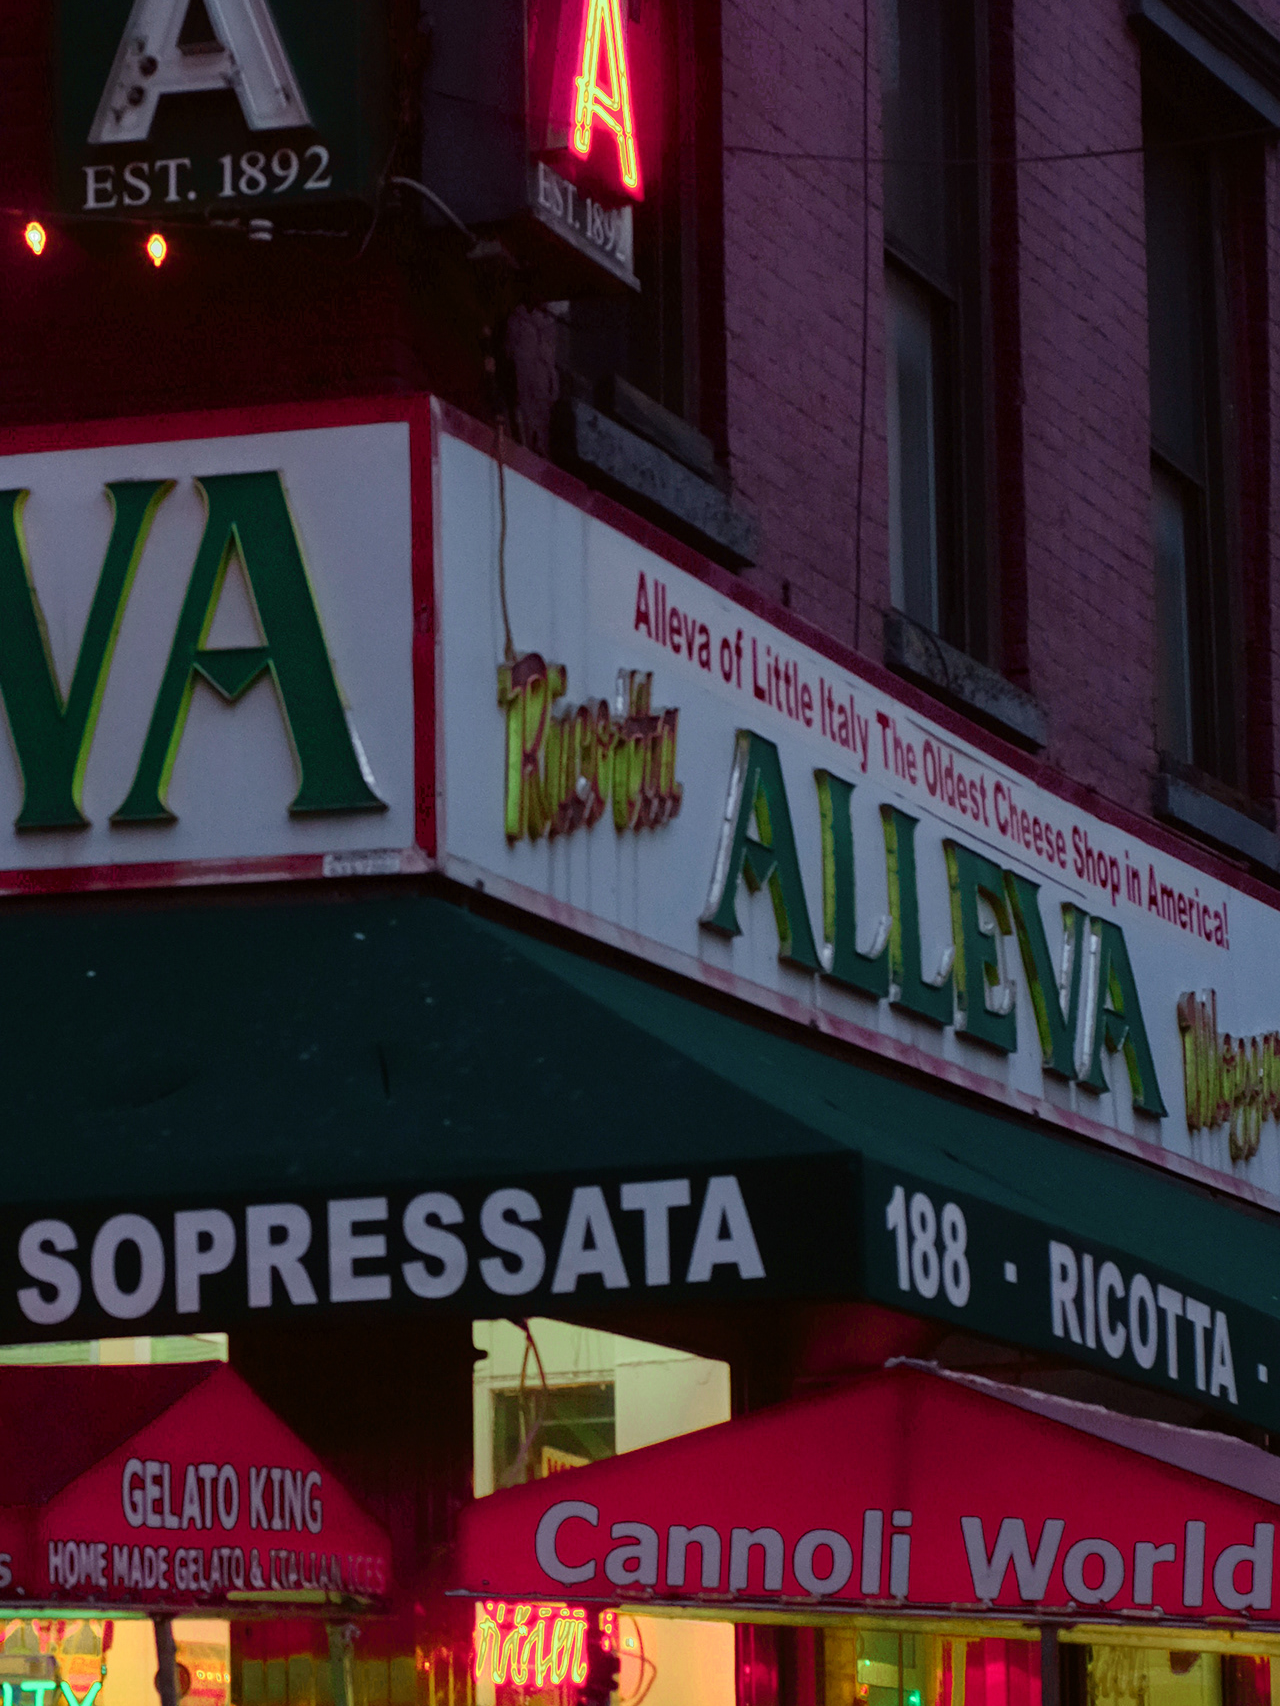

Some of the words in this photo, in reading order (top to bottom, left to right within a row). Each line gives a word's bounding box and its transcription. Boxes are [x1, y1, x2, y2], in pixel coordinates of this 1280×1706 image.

[82, 158, 197, 210] EST.
[219, 145, 332, 197] 1892
[634, 570, 711, 672] Alleva
[721, 628, 742, 689] of
[752, 637, 814, 728] Little
[820, 677, 869, 773] Italy
[877, 710, 918, 786] The
[923, 738, 989, 827] Oldest
[993, 780, 1067, 870] Cheese
[1072, 825, 1121, 907] Shop
[1125, 850, 1143, 907] in
[1148, 863, 1230, 951] America!
[699, 728, 1169, 1119] ALLEVA
[15, 1174, 767, 1326] SOPRESSATA
[885, 1184, 971, 1308] 188
[1048, 1239, 1239, 1406] RICOTTA
[122, 1458, 240, 1531] GELATO
[249, 1466, 323, 1535] KING
[534, 1500, 913, 1601] Cannoli
[960, 1515, 1275, 1611] World
[48, 1541, 109, 1589] HOME
[112, 1545, 170, 1590] MADE
[173, 1547, 246, 1591] GELATO
[249, 1548, 267, 1590] &
[269, 1549, 342, 1592] ITALIAN
